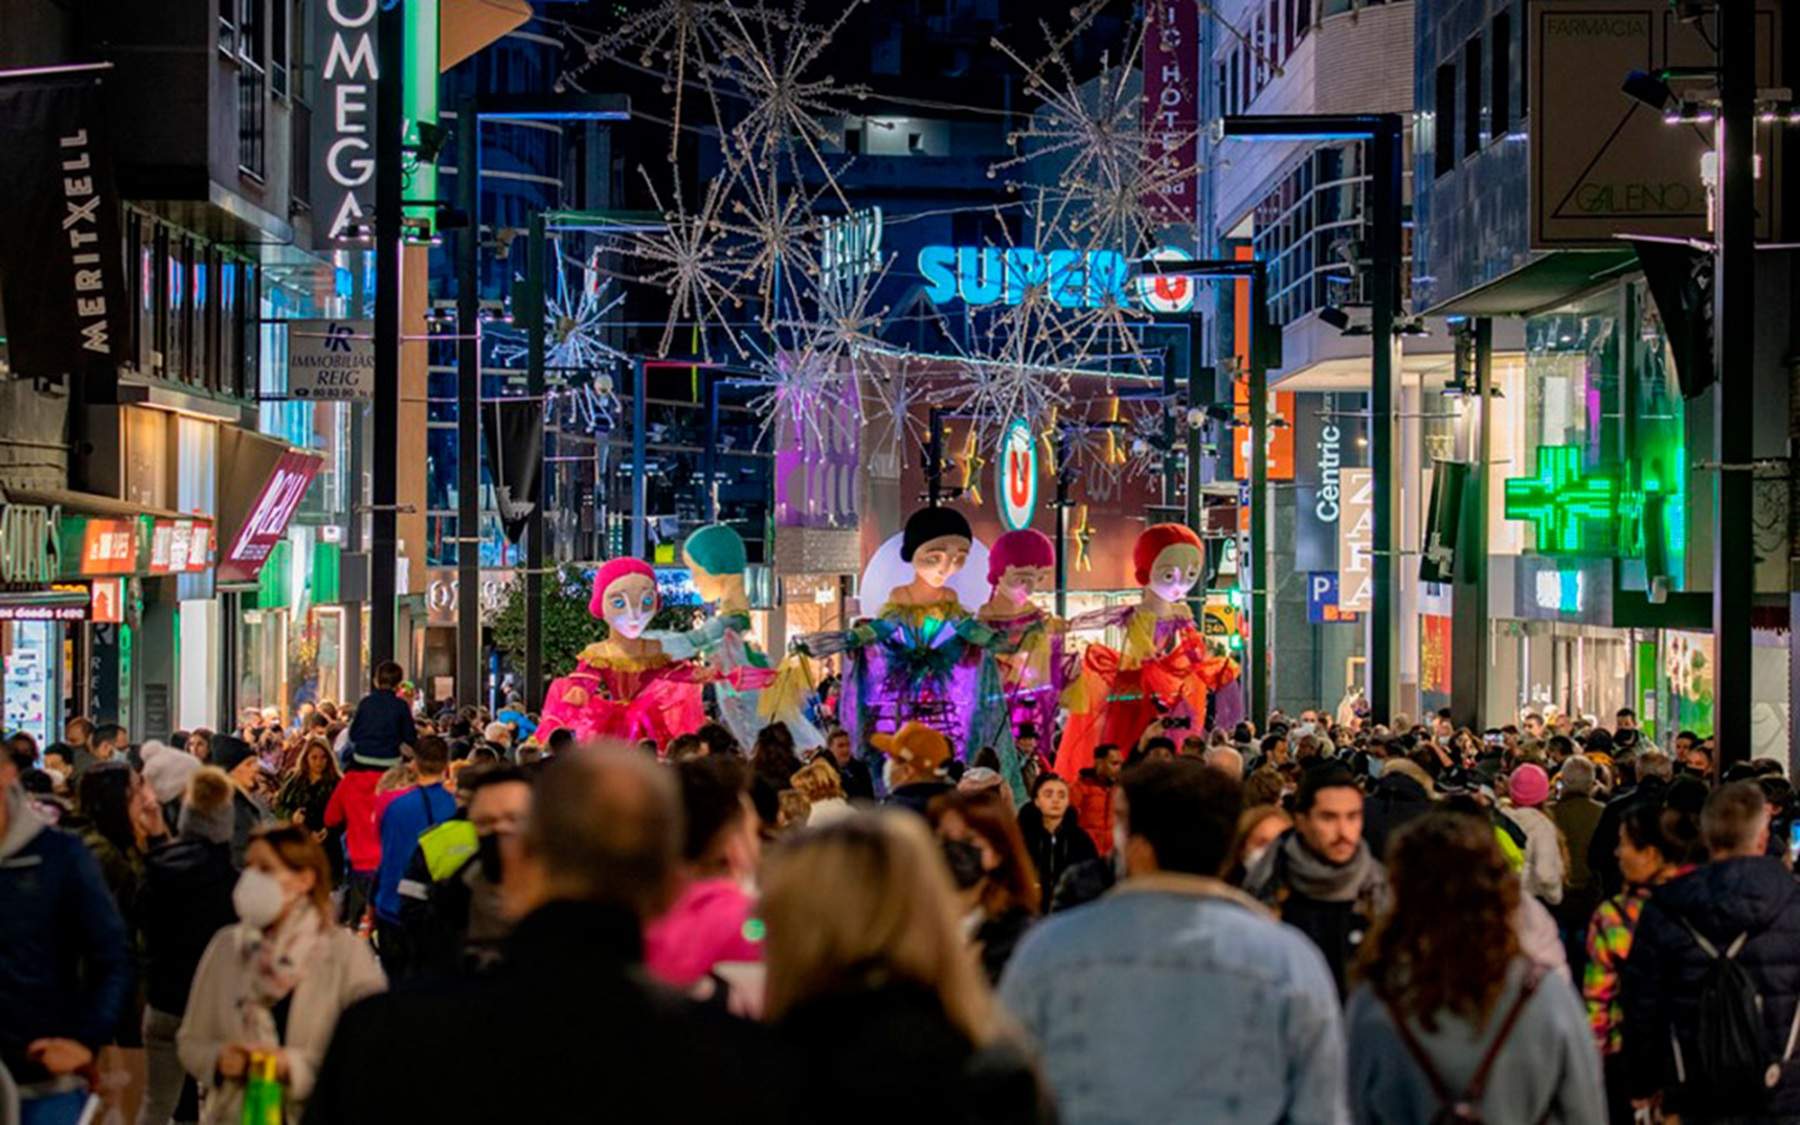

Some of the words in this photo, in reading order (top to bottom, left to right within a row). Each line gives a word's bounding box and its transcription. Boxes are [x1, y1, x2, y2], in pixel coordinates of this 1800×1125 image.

[60, 128, 110, 354] MERITXELL
[918, 245, 1129, 308] SUPER
[317, 369, 360, 386] REIG
[1009, 450, 1030, 509] U
[1316, 425, 1341, 522] Cèntric
[1313, 577, 1331, 602] P
